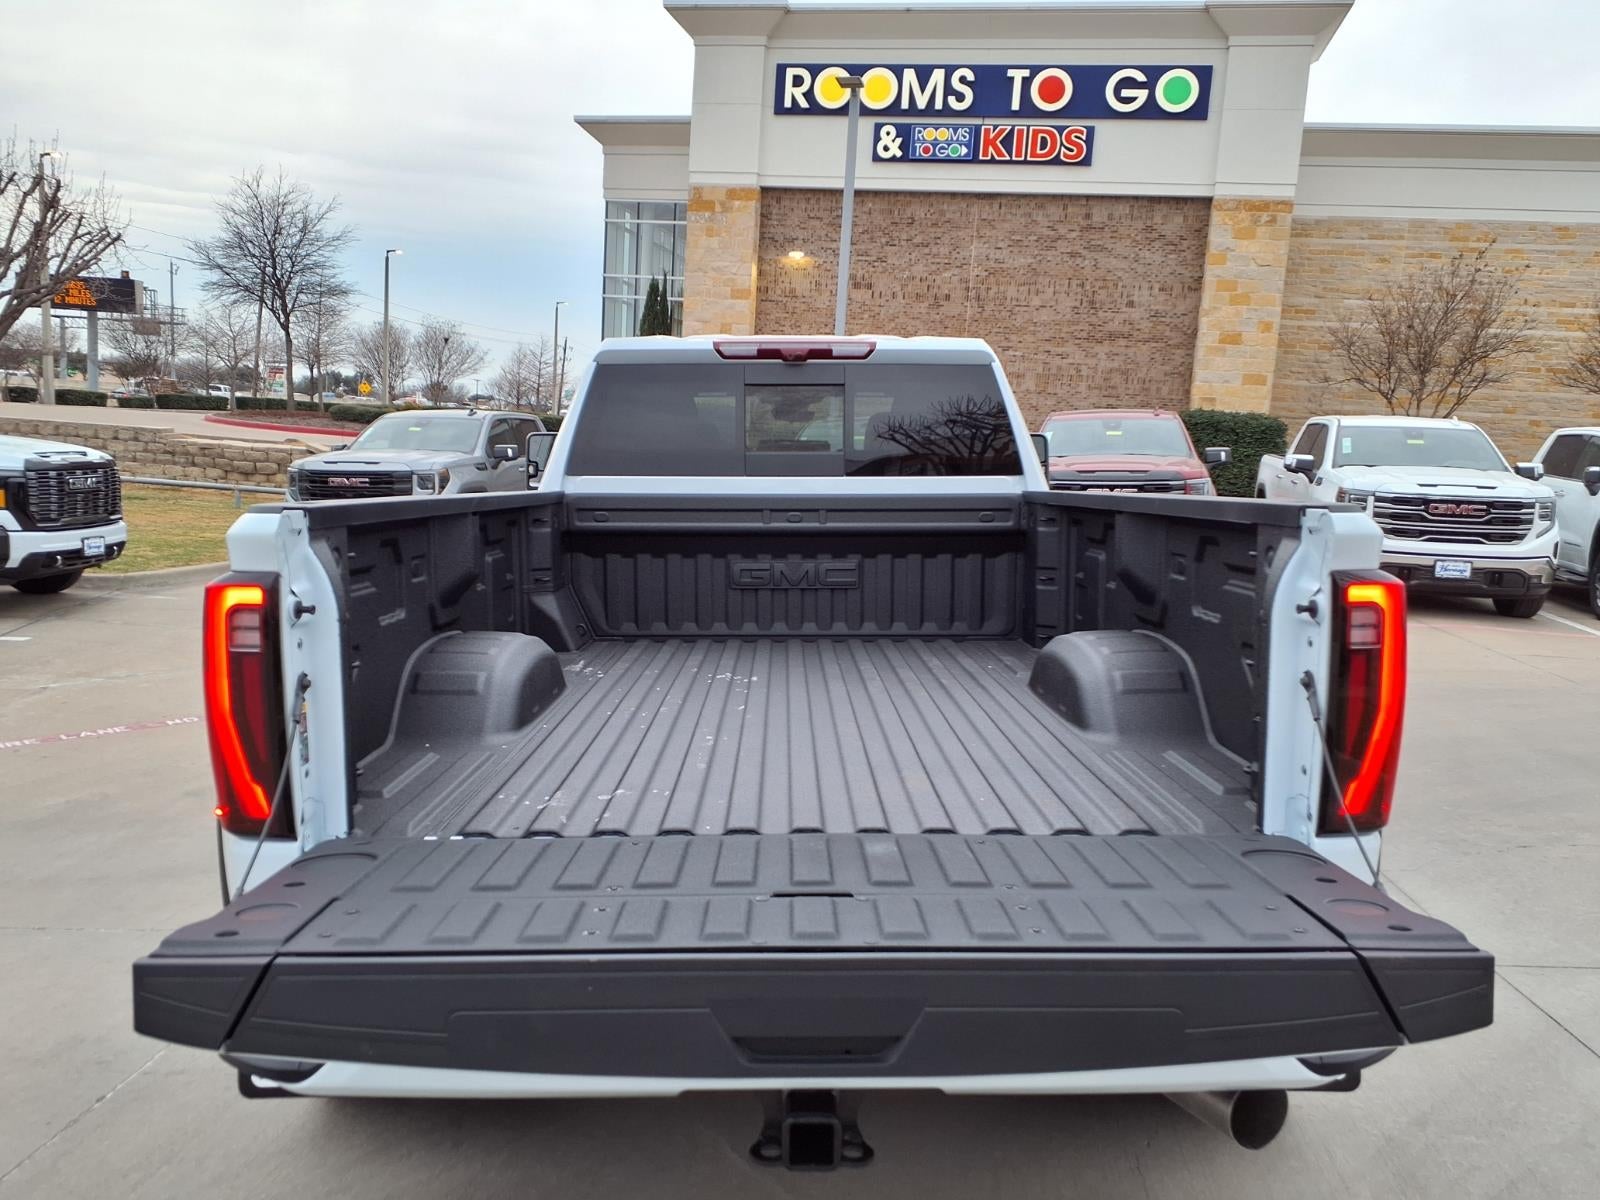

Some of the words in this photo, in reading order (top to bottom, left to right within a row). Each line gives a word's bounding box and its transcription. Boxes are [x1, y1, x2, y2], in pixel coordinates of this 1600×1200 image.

[783, 66, 976, 112] ROOMS
[1007, 67, 1074, 112] TO
[1105, 68, 1200, 113] GO
[876, 124, 903, 159] &
[914, 127, 970, 142] ROOMS
[914, 143, 934, 157] TO
[935, 143, 962, 157] GO
[979, 125, 1088, 163] KIDS
[65, 296, 97, 305] MINUTES
[327, 477, 369, 487] GMC
[1429, 503, 1487, 515] GMC
[732, 562, 858, 587] GMC
